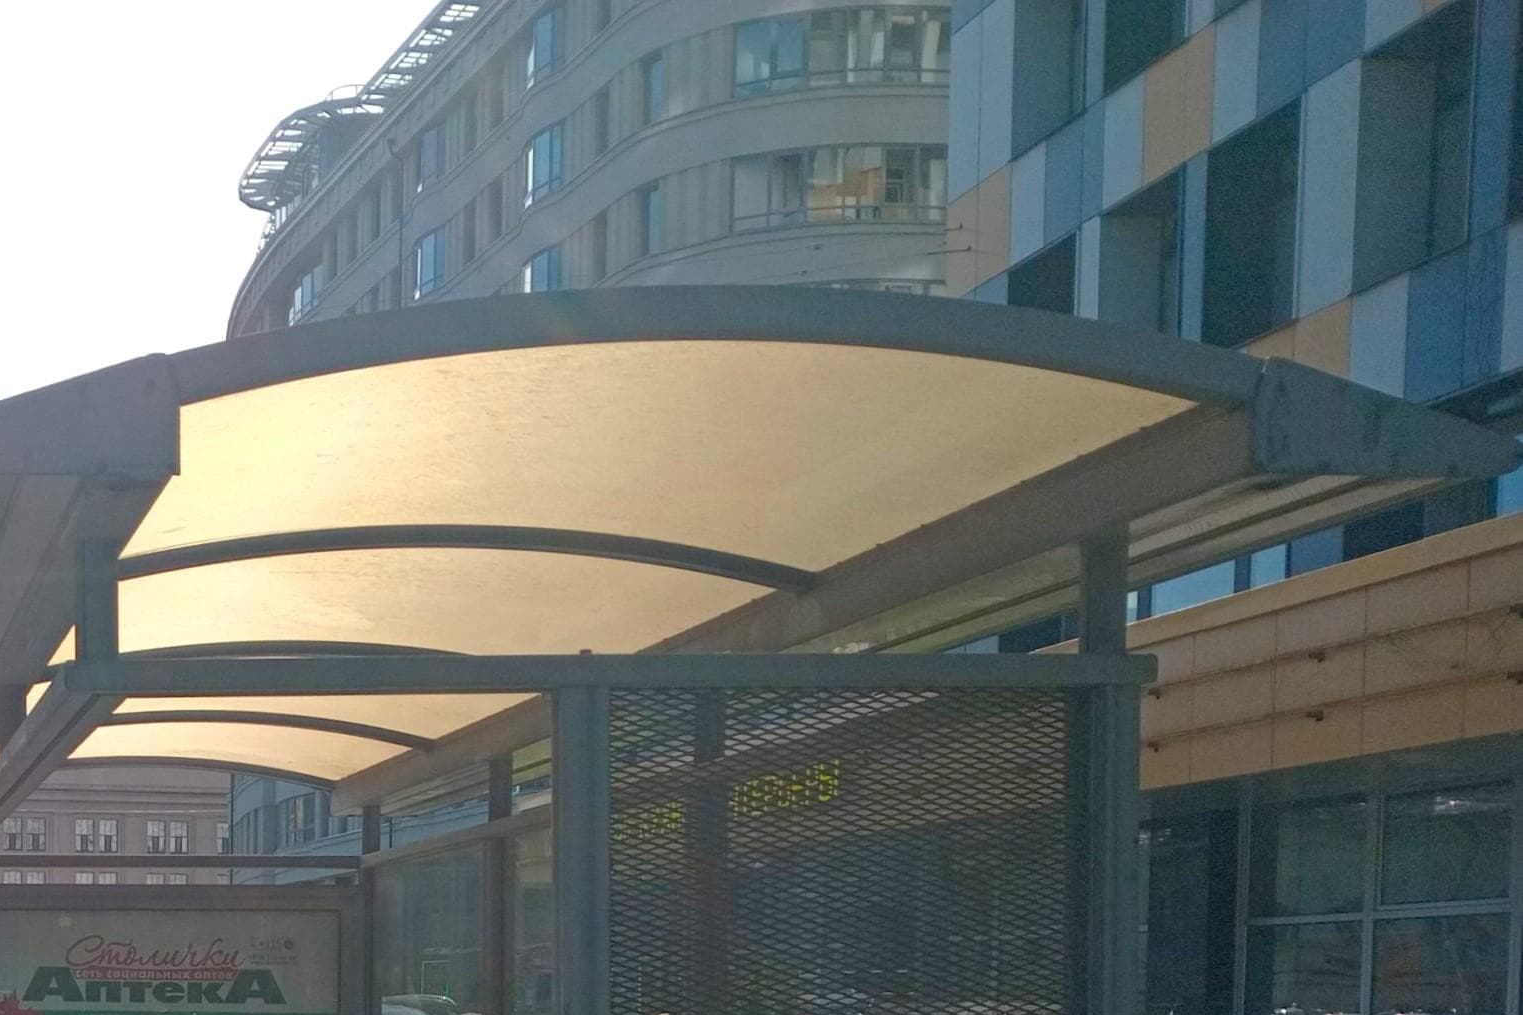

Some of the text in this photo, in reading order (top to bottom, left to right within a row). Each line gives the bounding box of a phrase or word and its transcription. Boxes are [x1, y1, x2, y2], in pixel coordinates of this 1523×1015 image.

[65, 935, 245, 967] Столички
[76, 969, 234, 980] сеть социальных аптек
